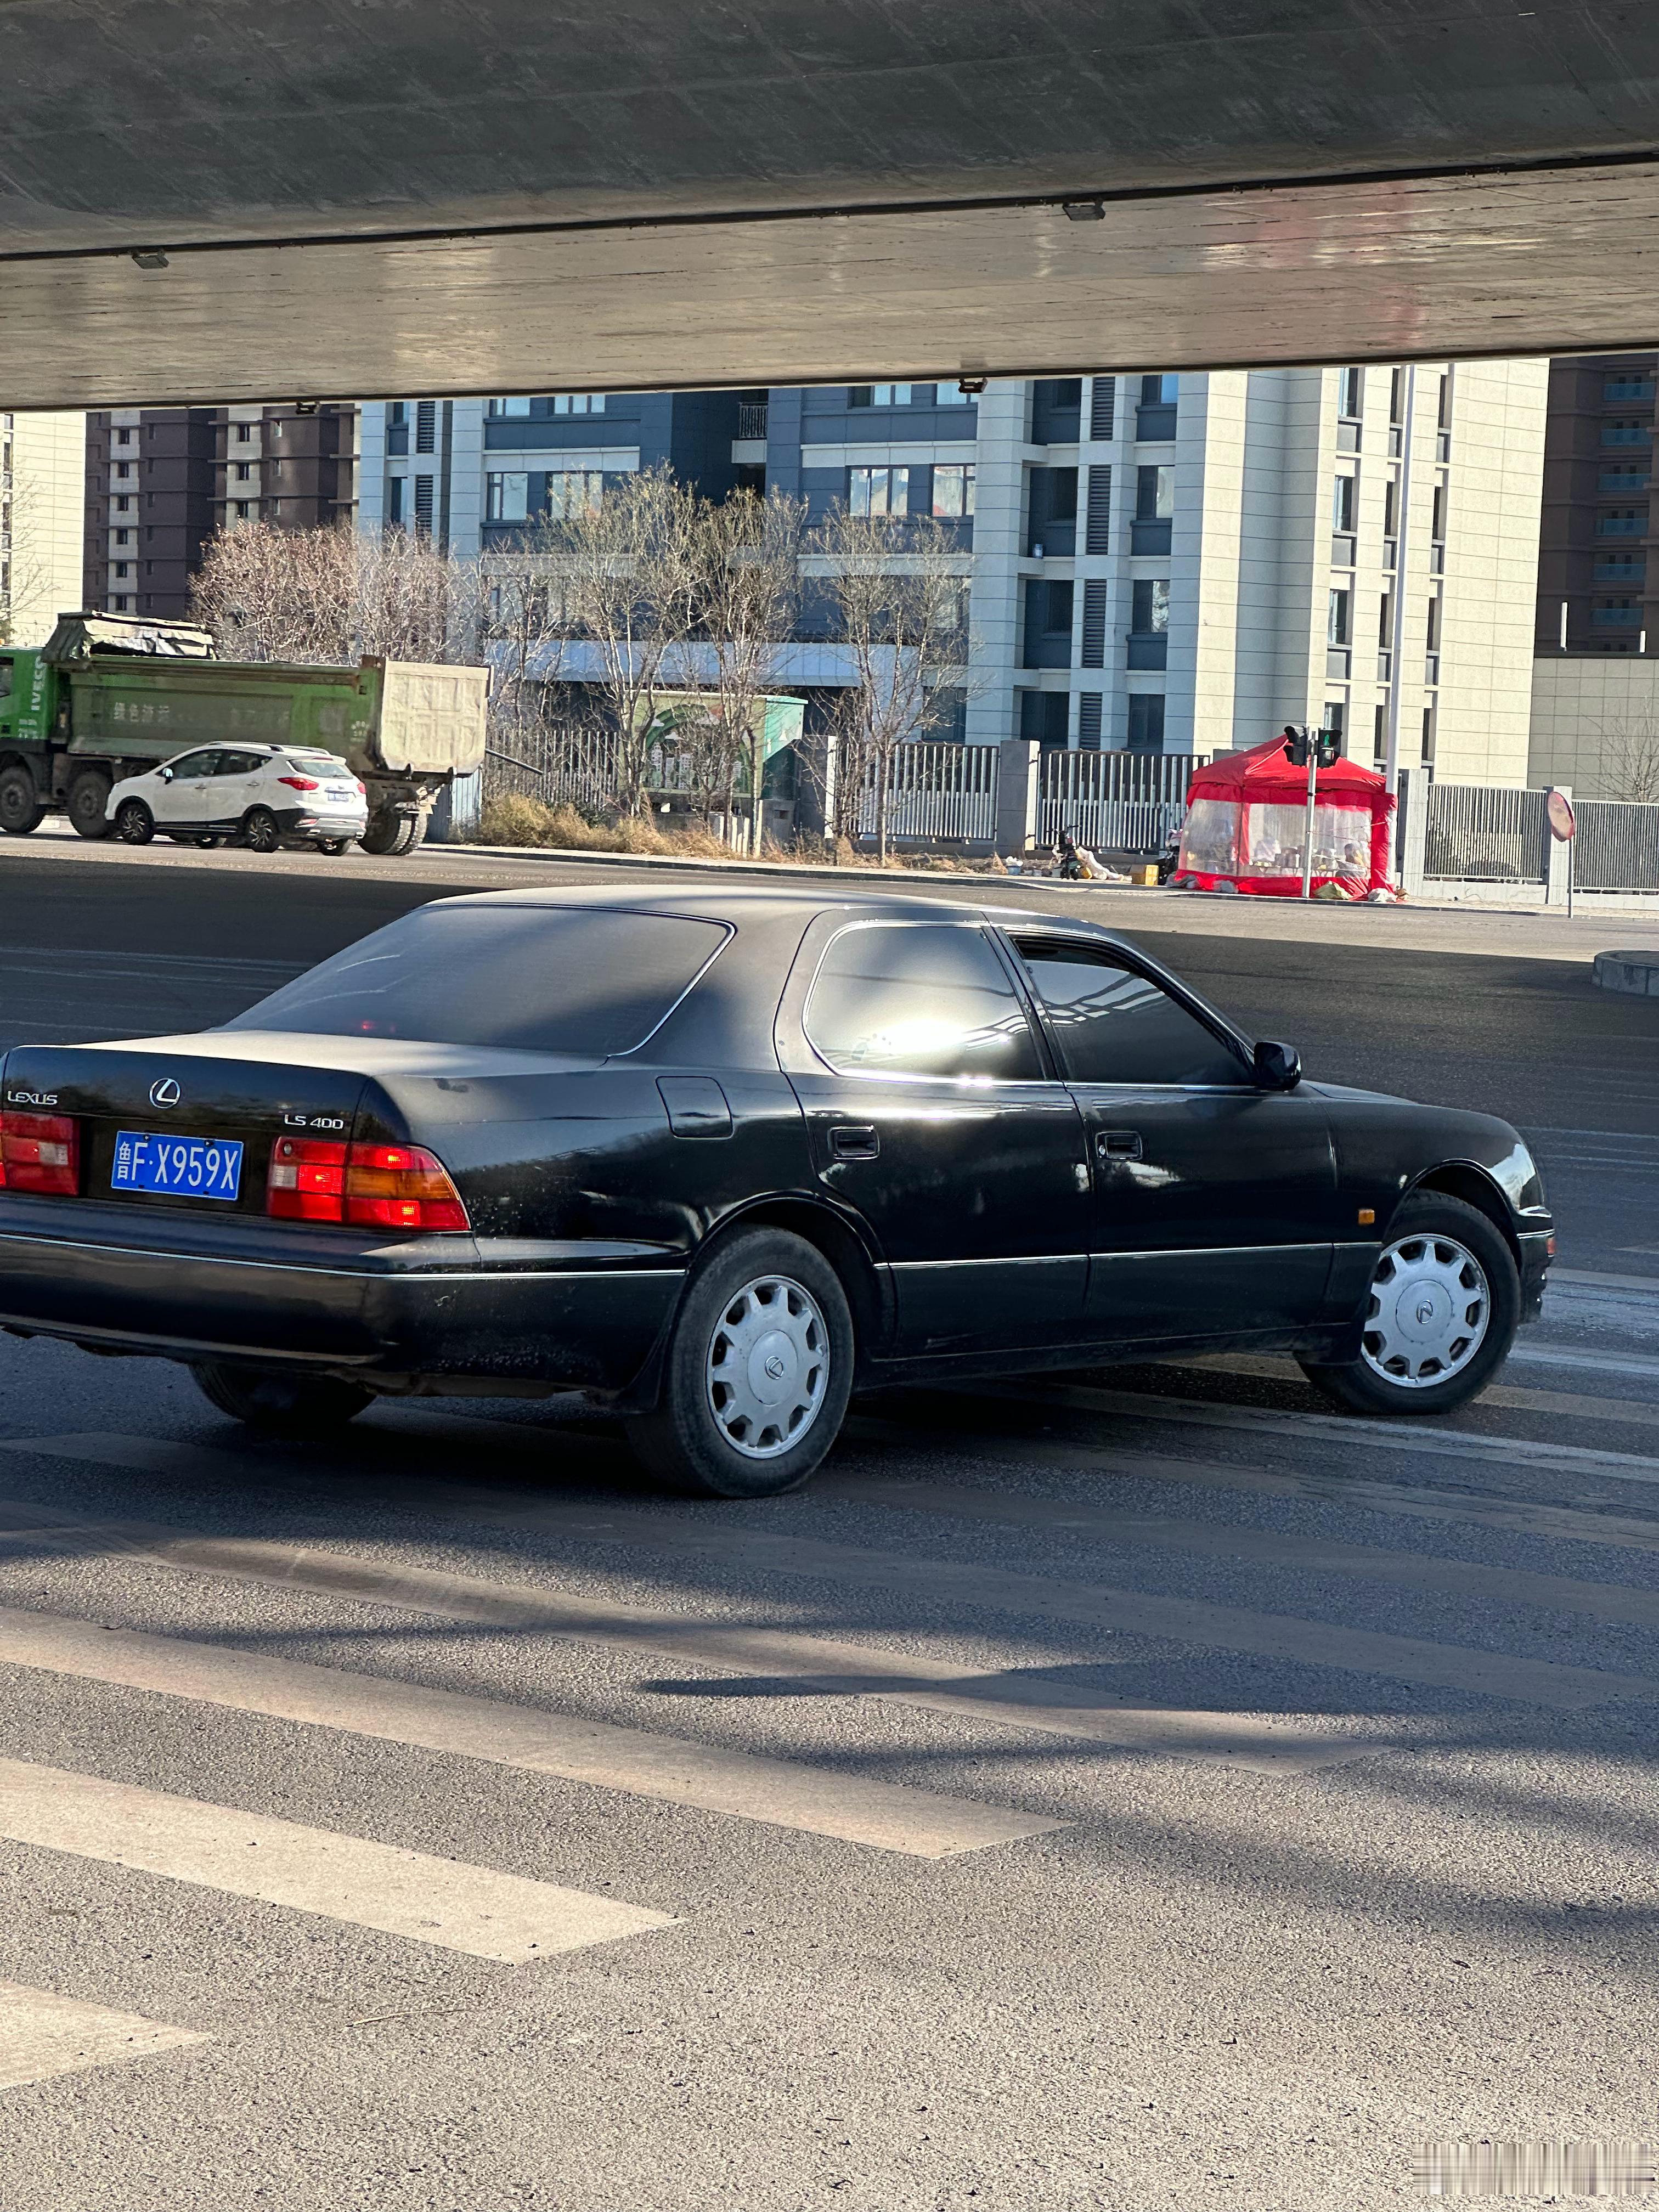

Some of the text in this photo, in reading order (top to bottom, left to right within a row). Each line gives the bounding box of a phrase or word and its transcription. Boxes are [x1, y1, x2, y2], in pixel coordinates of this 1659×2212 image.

[7, 1090, 58, 1105] LEXUS
[284, 1114, 344, 1130] LS 400
[116, 1141, 239, 1190] 鲁F·X959X
